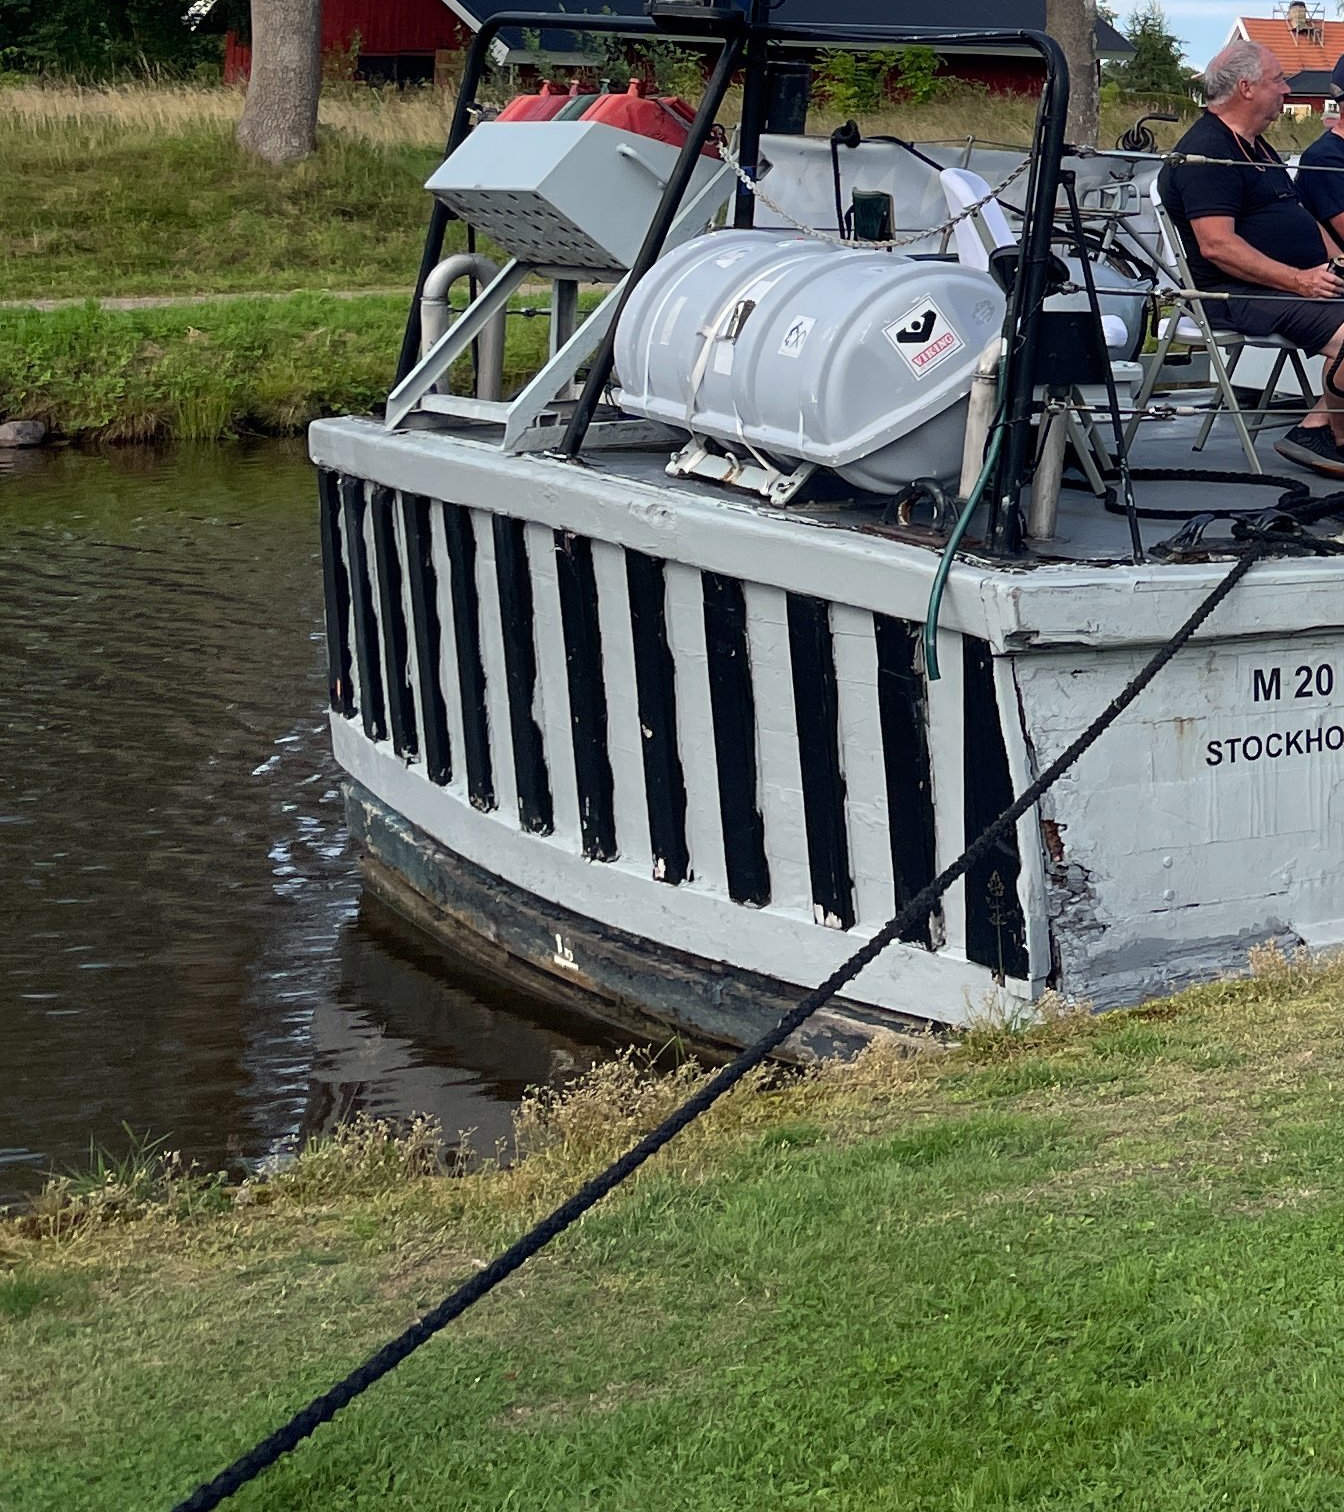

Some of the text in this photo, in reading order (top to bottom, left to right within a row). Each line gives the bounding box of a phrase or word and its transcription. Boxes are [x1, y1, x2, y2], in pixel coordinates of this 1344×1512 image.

[911, 332, 955, 367] VIKING
[1253, 663, 1334, 702] M 20
